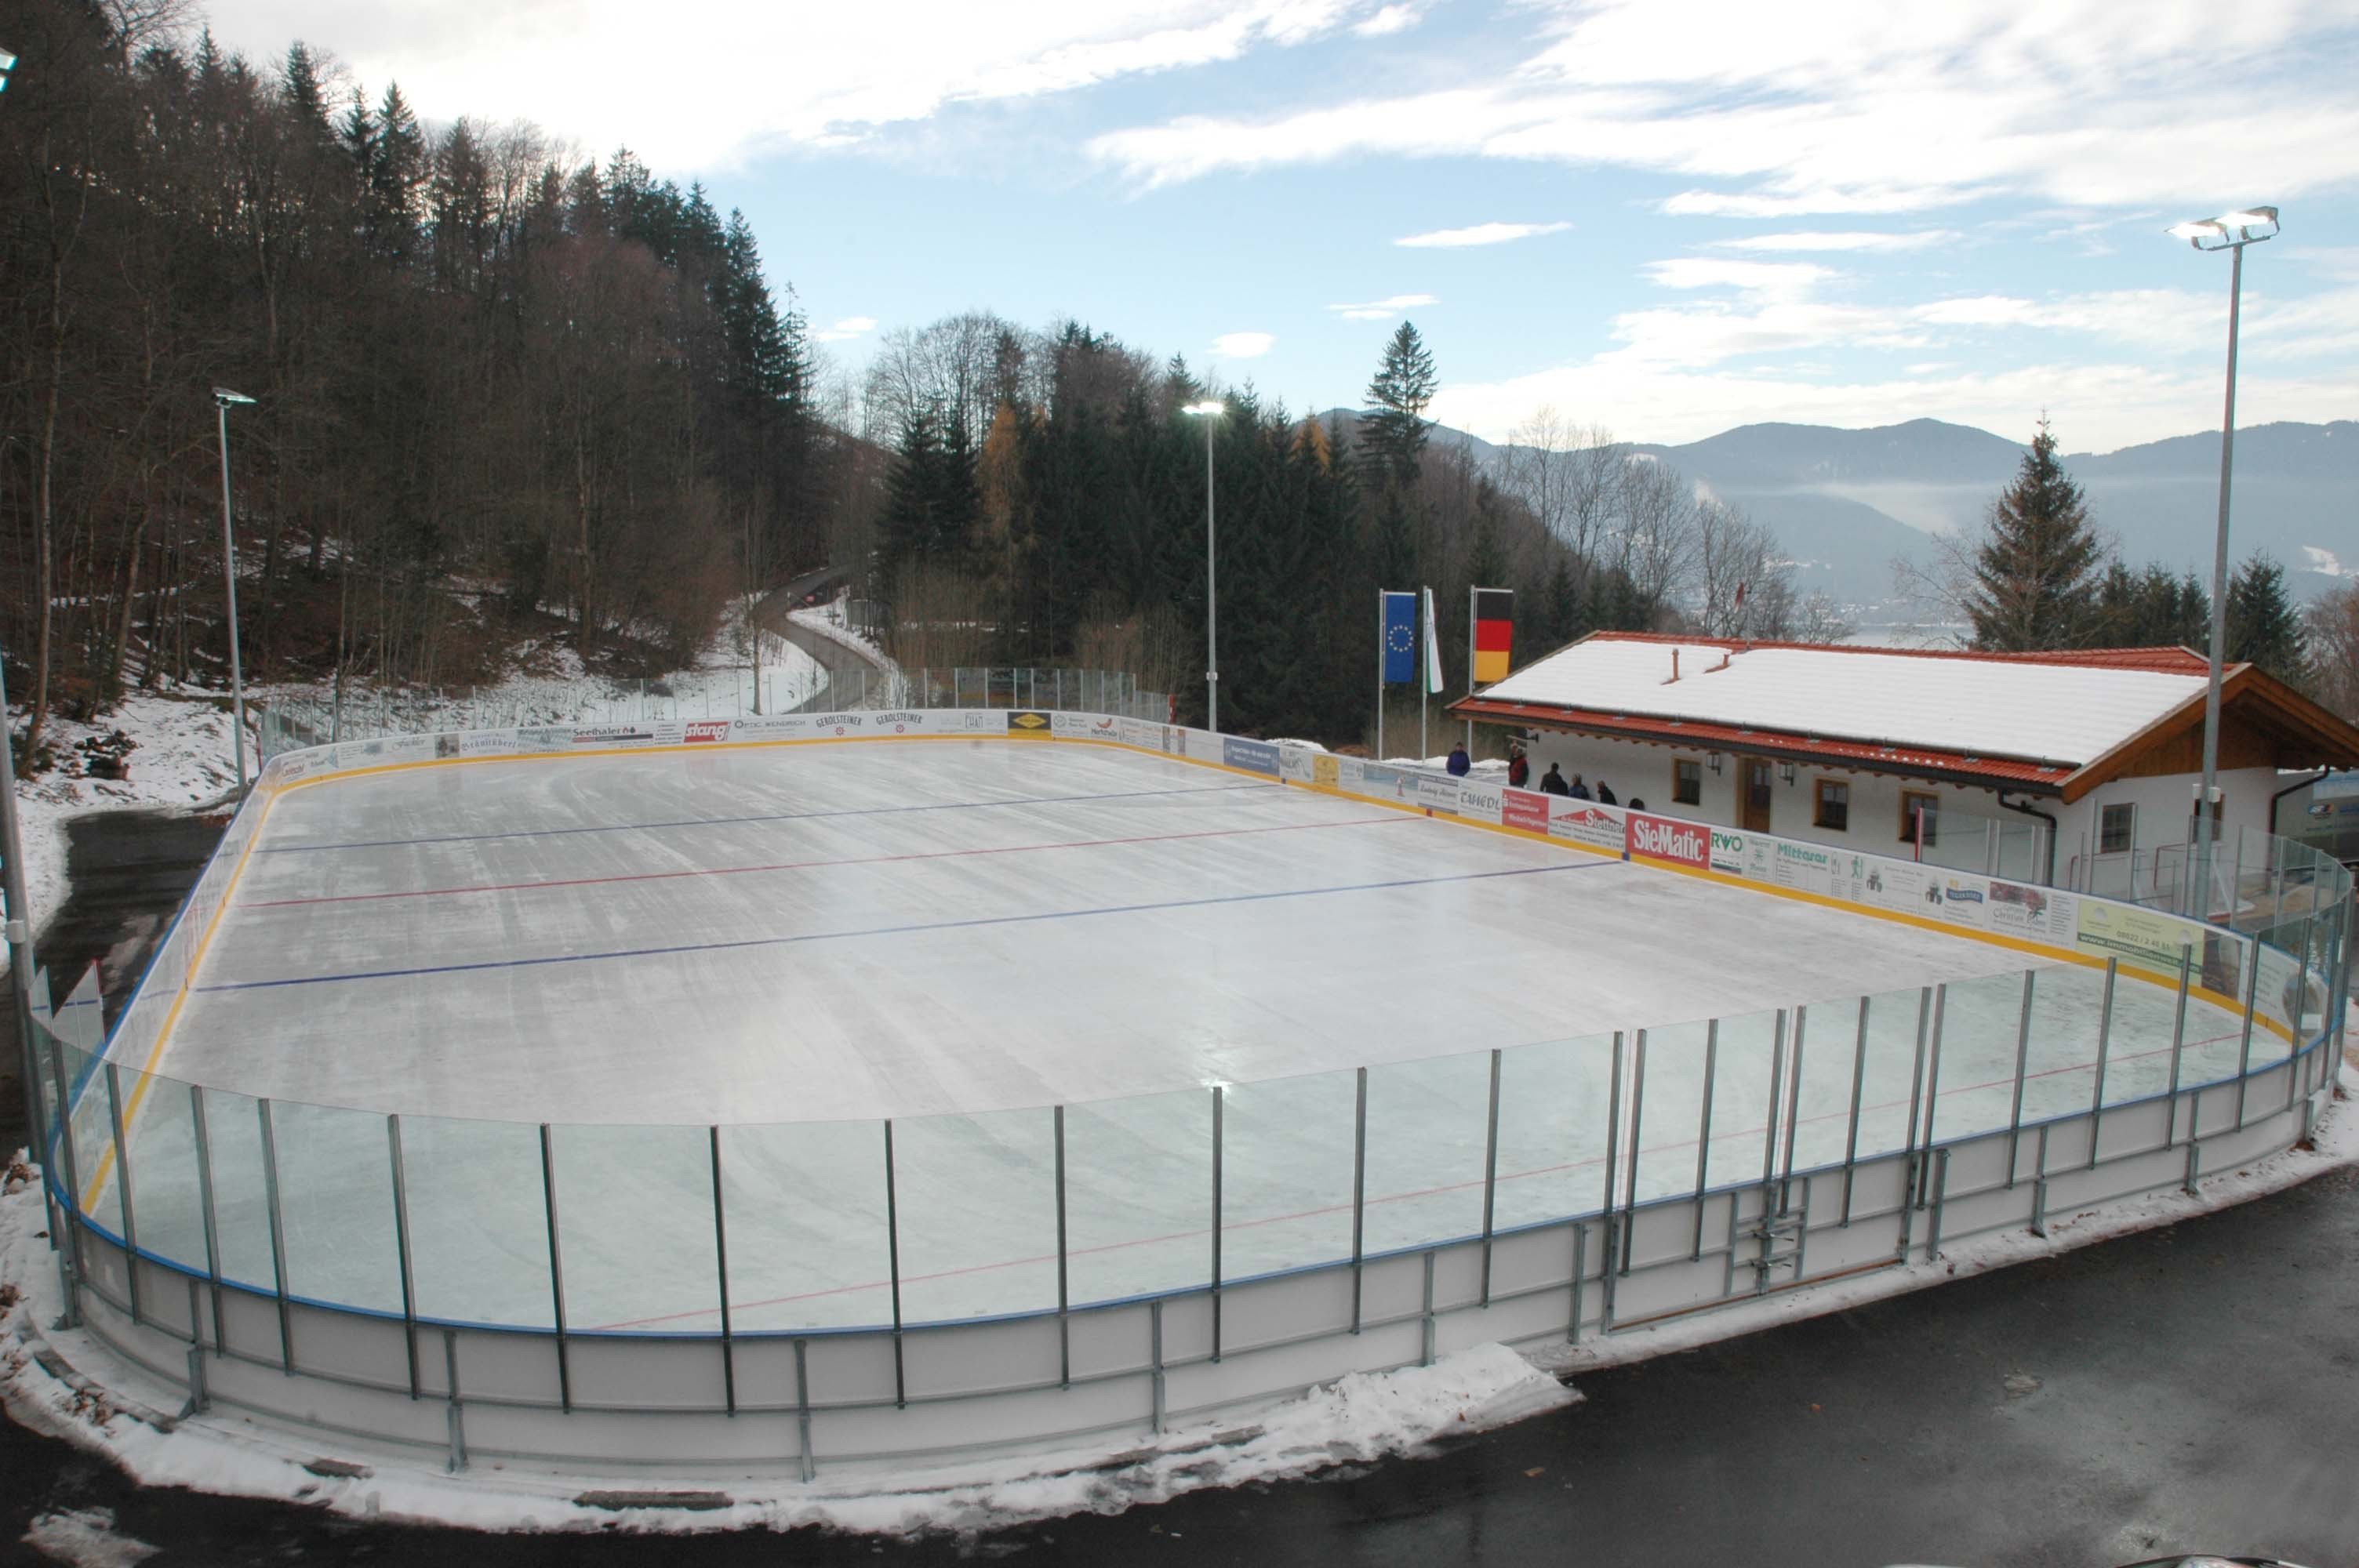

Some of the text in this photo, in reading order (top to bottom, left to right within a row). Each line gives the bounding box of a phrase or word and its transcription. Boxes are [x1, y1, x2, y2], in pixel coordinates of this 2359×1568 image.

[816, 715, 862, 728] GEROLSTEINER
[876, 713, 923, 725] GEROLSTEINER
[1586, 810, 1625, 833] Stettner
[1634, 819, 1703, 862] SieMatic
